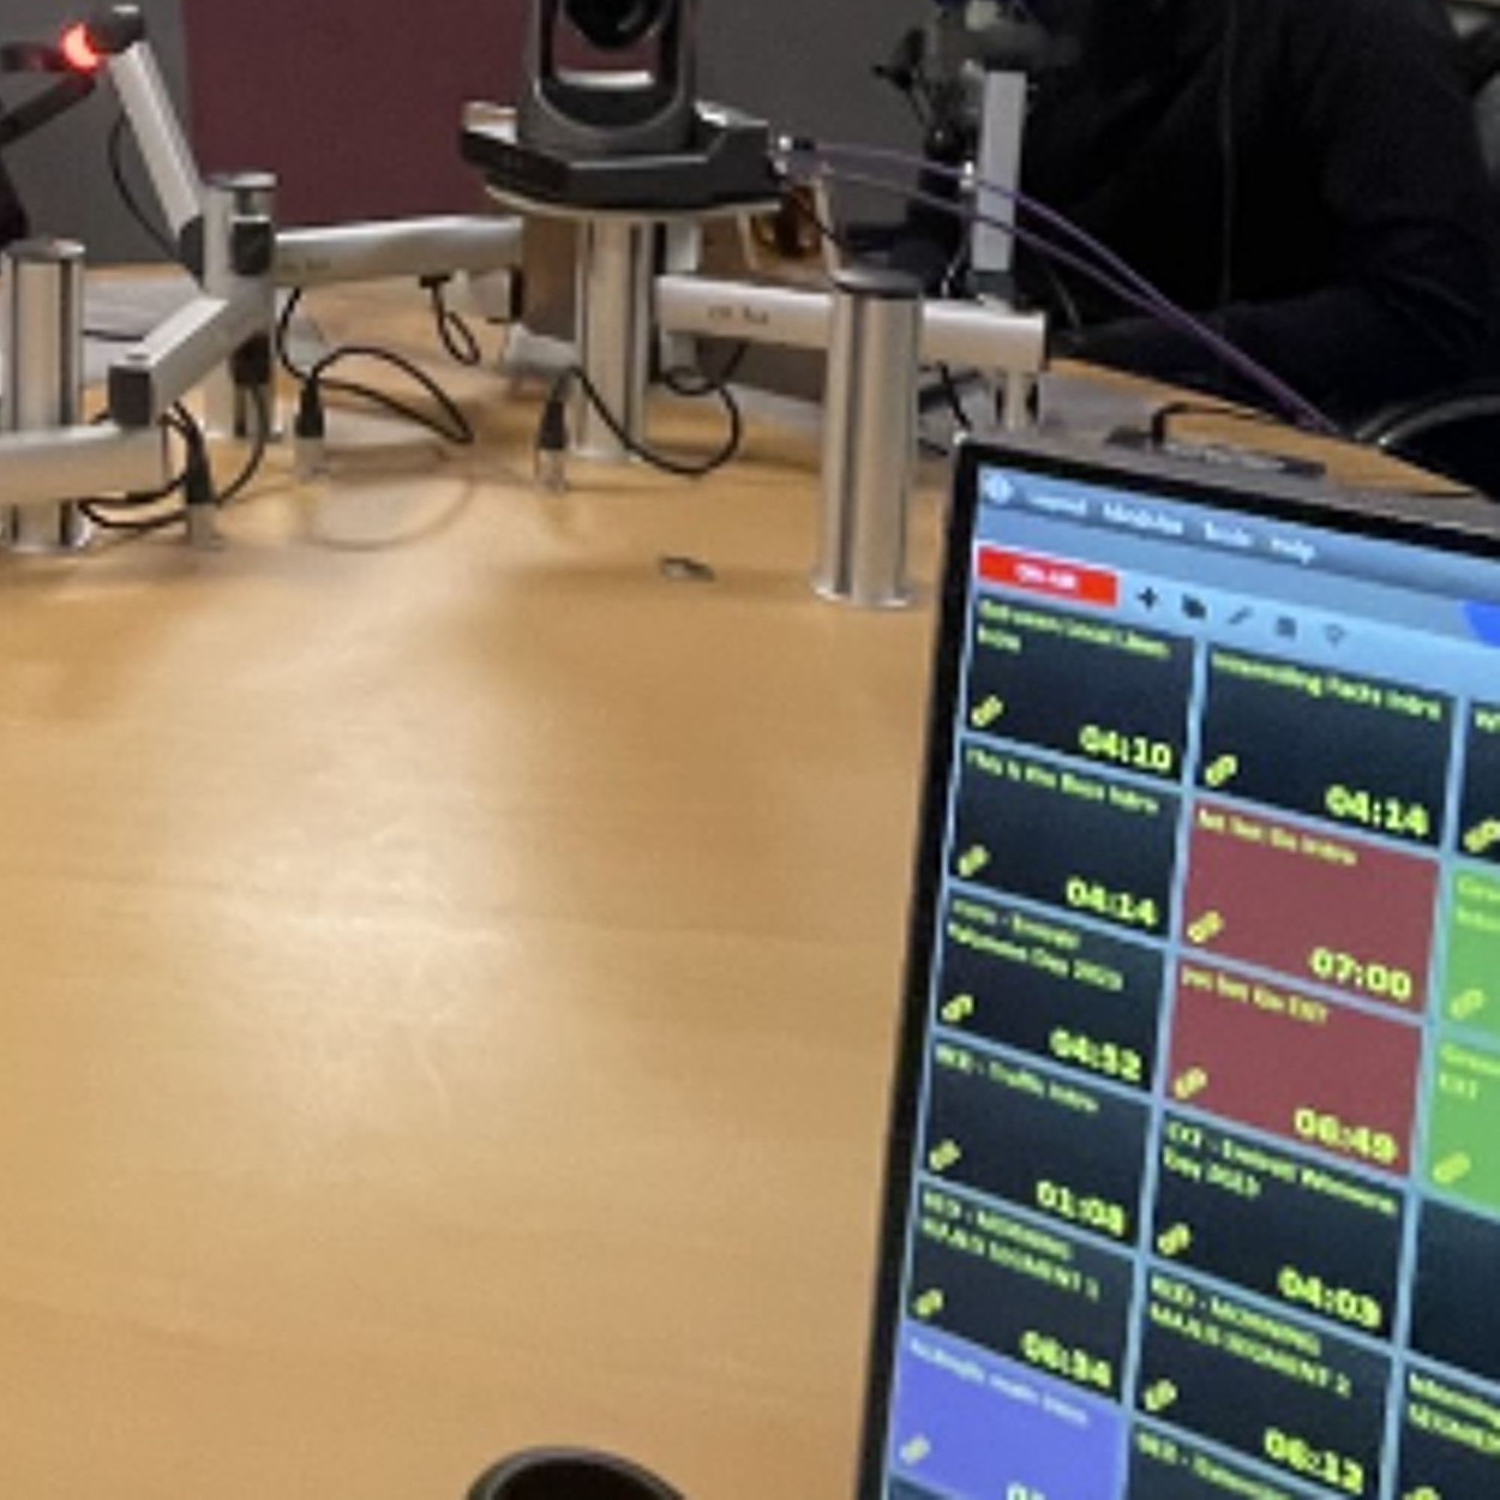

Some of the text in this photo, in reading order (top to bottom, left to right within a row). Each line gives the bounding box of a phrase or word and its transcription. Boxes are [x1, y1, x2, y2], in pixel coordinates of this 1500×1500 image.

[1079, 724, 1172, 772] 04:10
[1324, 784, 1429, 836] 04:14
[1066, 876, 1158, 928] 04:14
[1310, 947, 1411, 1000] 07:00
